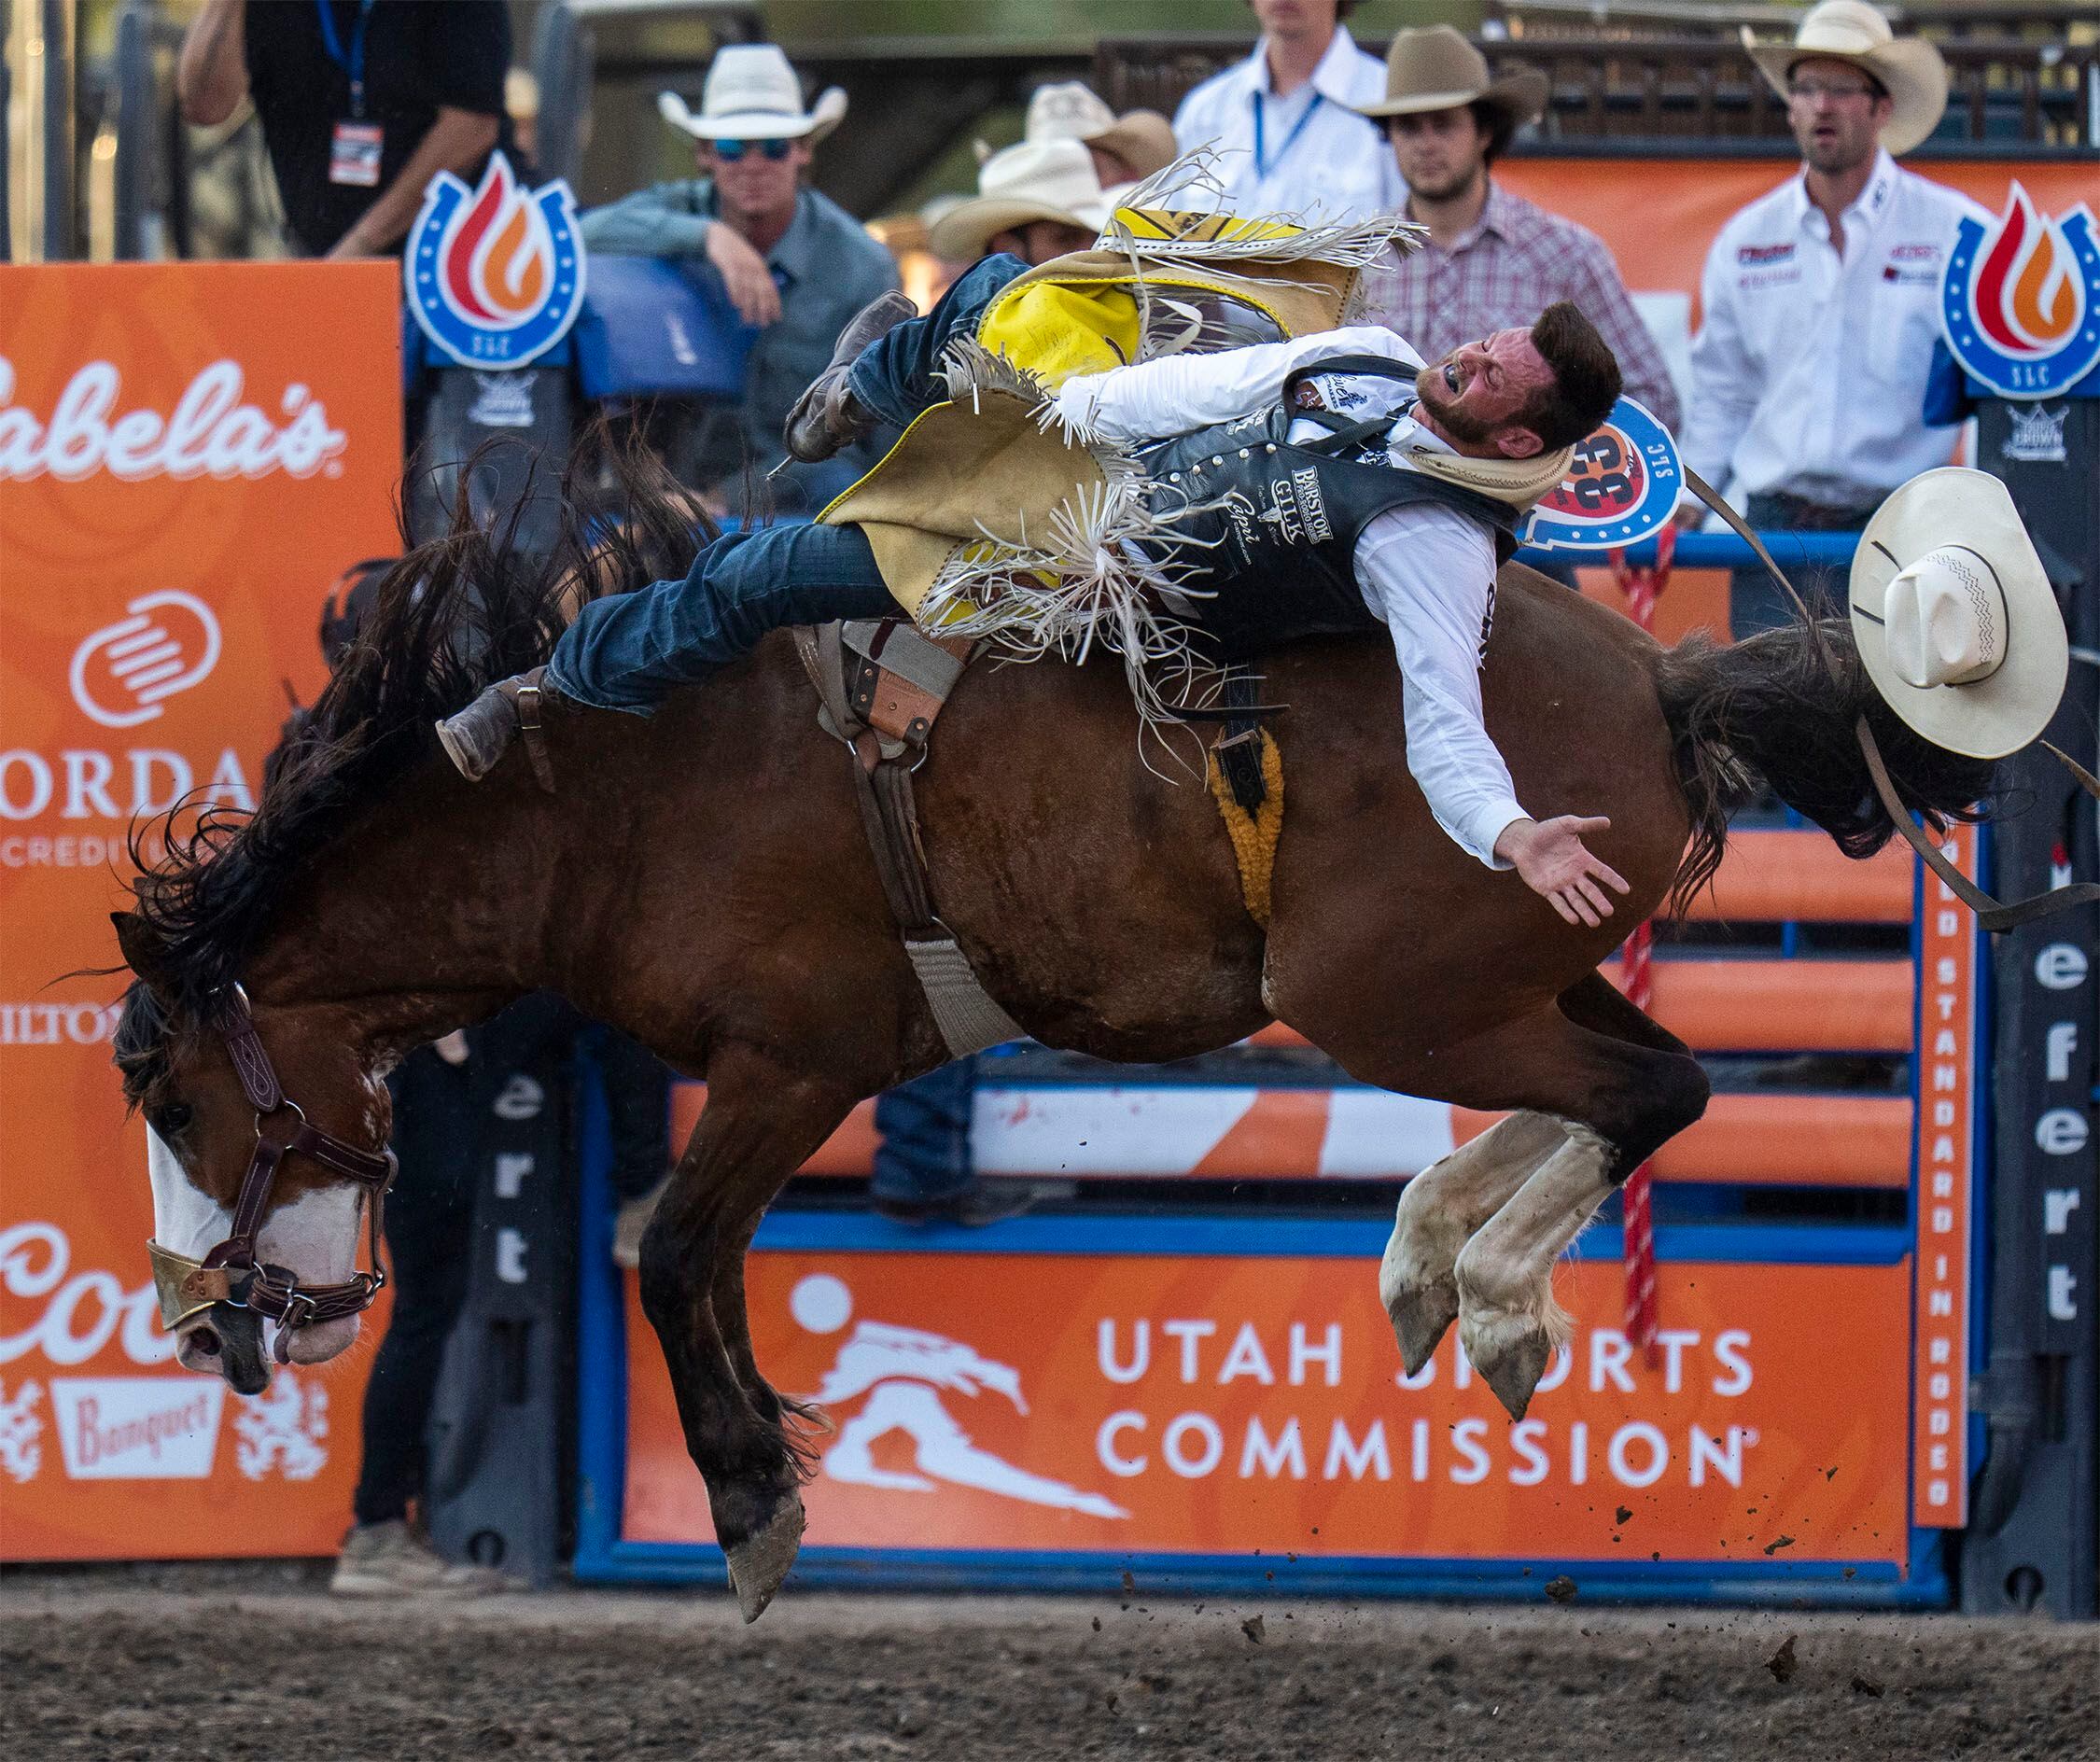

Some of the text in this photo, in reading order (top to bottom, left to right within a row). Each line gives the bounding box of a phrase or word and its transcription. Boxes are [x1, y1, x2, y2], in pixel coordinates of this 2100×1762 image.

[2012, 364, 2050, 386] SLC
[0, 355, 347, 478] abela's
[1646, 443, 1674, 479] SLC
[1225, 492, 1259, 543] Capri
[1275, 481, 1305, 541] GILK
[1294, 468, 1330, 539] BARSTOW
[1931, 958, 1956, 1235] STANDARD
[1928, 1255, 1953, 1318] IN
[1098, 1318, 1342, 1388] UTAH
[1096, 1410, 1743, 1489] COMMISSION
[1928, 1336, 1950, 1507] RODEO
